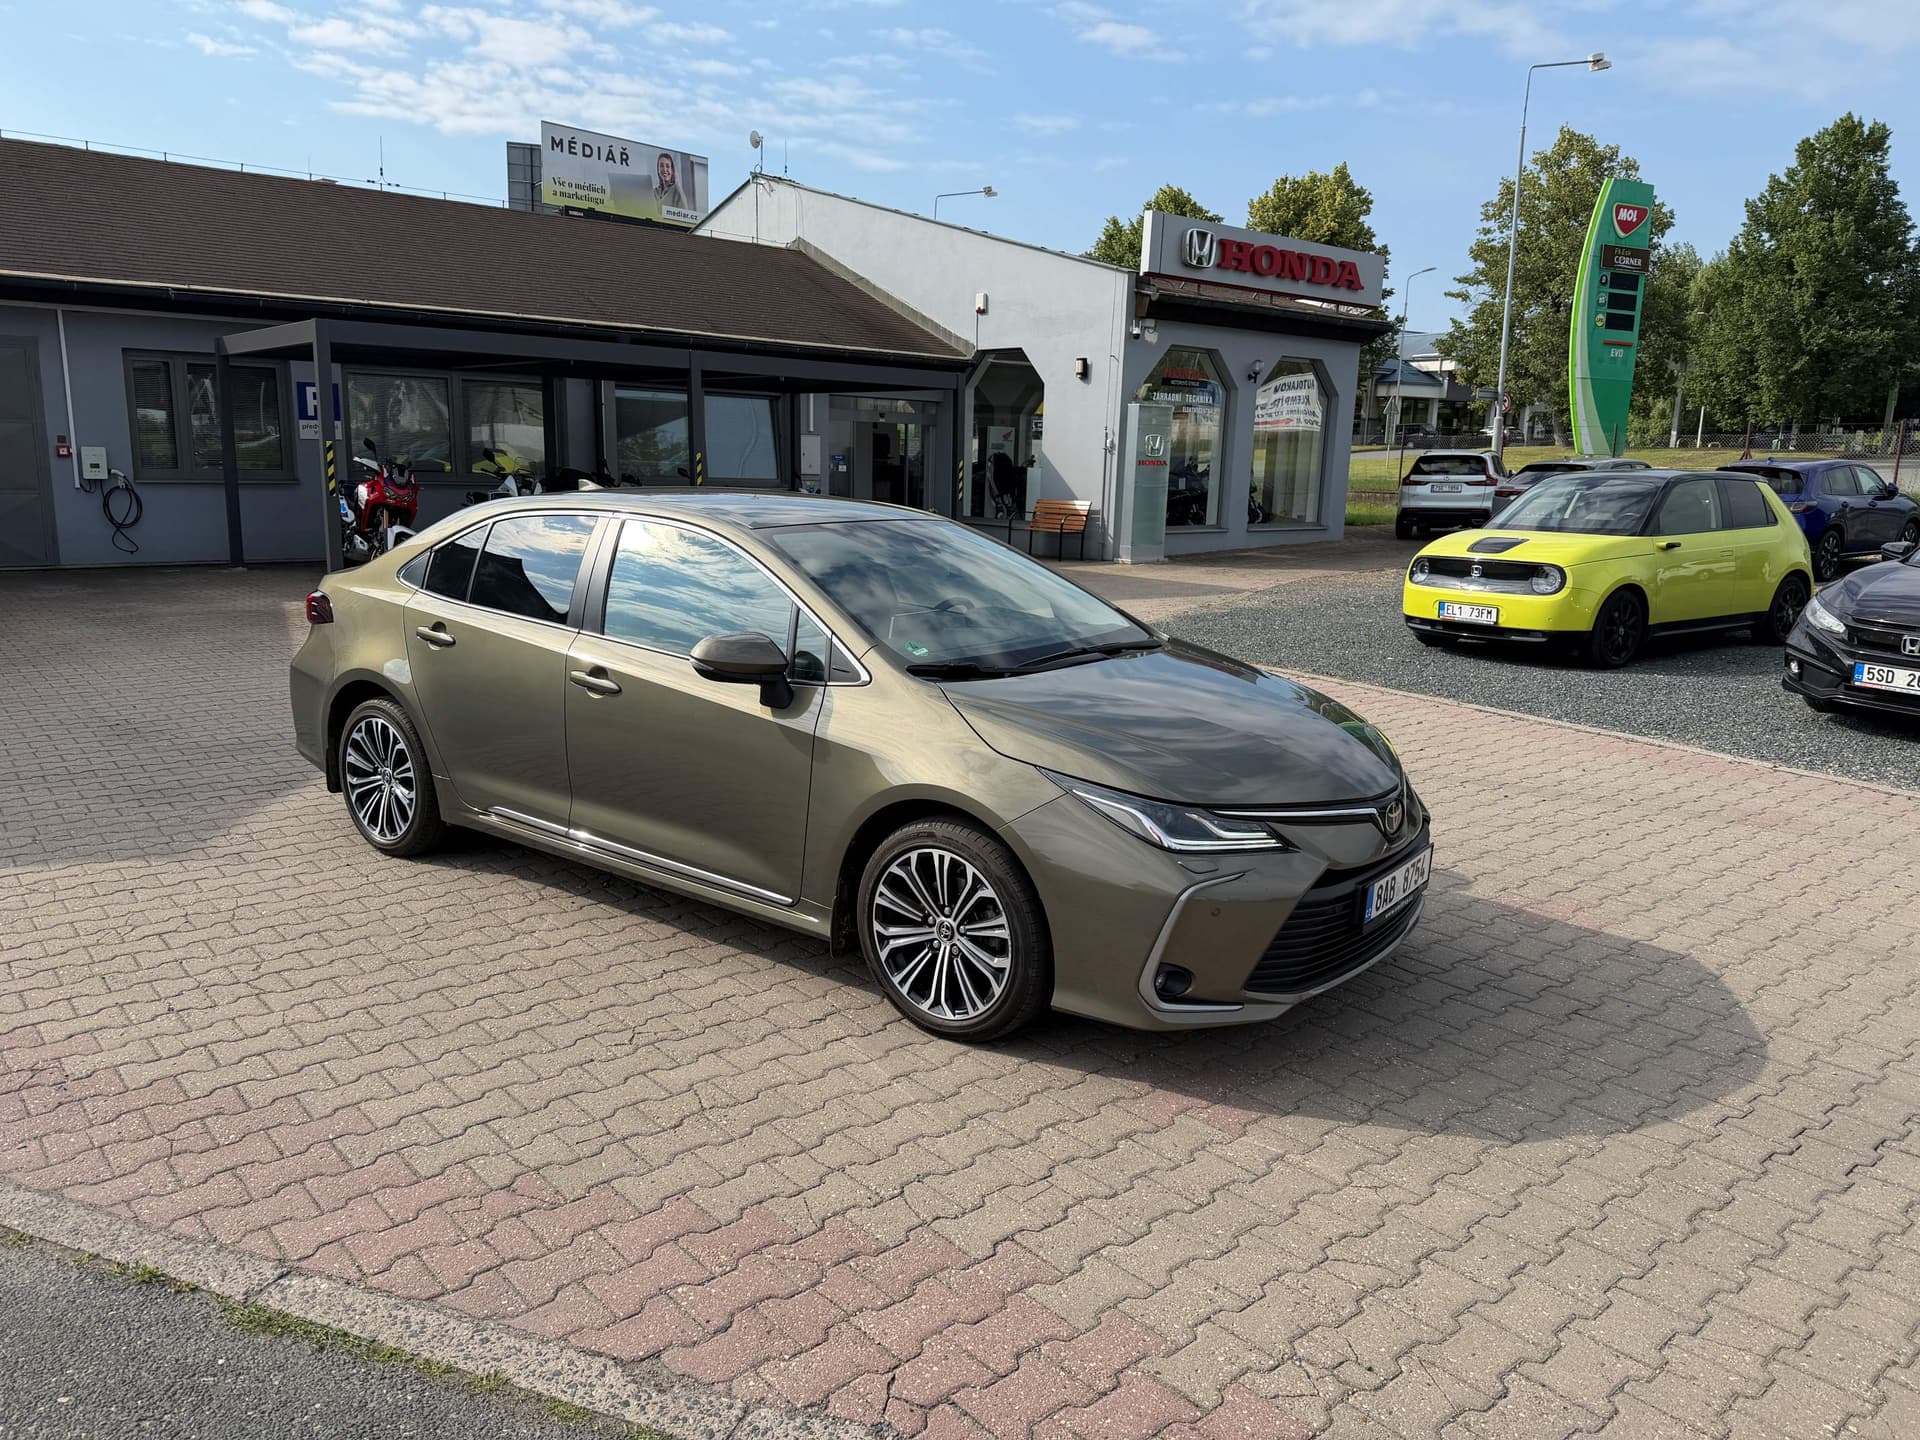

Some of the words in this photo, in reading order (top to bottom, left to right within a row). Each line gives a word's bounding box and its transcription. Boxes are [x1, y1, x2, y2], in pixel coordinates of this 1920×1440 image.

[550, 135, 630, 167] MÉDIÁŘ
[552, 176, 567, 187] Vše
[574, 179, 606, 195] médiích
[558, 189, 605, 206] marketingu
[666, 208, 698, 221] mediar.cz
[1617, 207, 1638, 222] MOL
[1216, 238, 1365, 291] HONDA
[1614, 255, 1642, 266] CORNER
[1610, 348, 1624, 358] EVO
[1185, 393, 1213, 404] TECHNIKA
[1137, 459, 1168, 467] HONDA
[1446, 604, 1463, 616] EL1
[1469, 607, 1493, 619] 73FM
[1866, 666, 1895, 684] 5SD
[1375, 875, 1397, 912] 8AB
[1402, 854, 1426, 894] 8754
